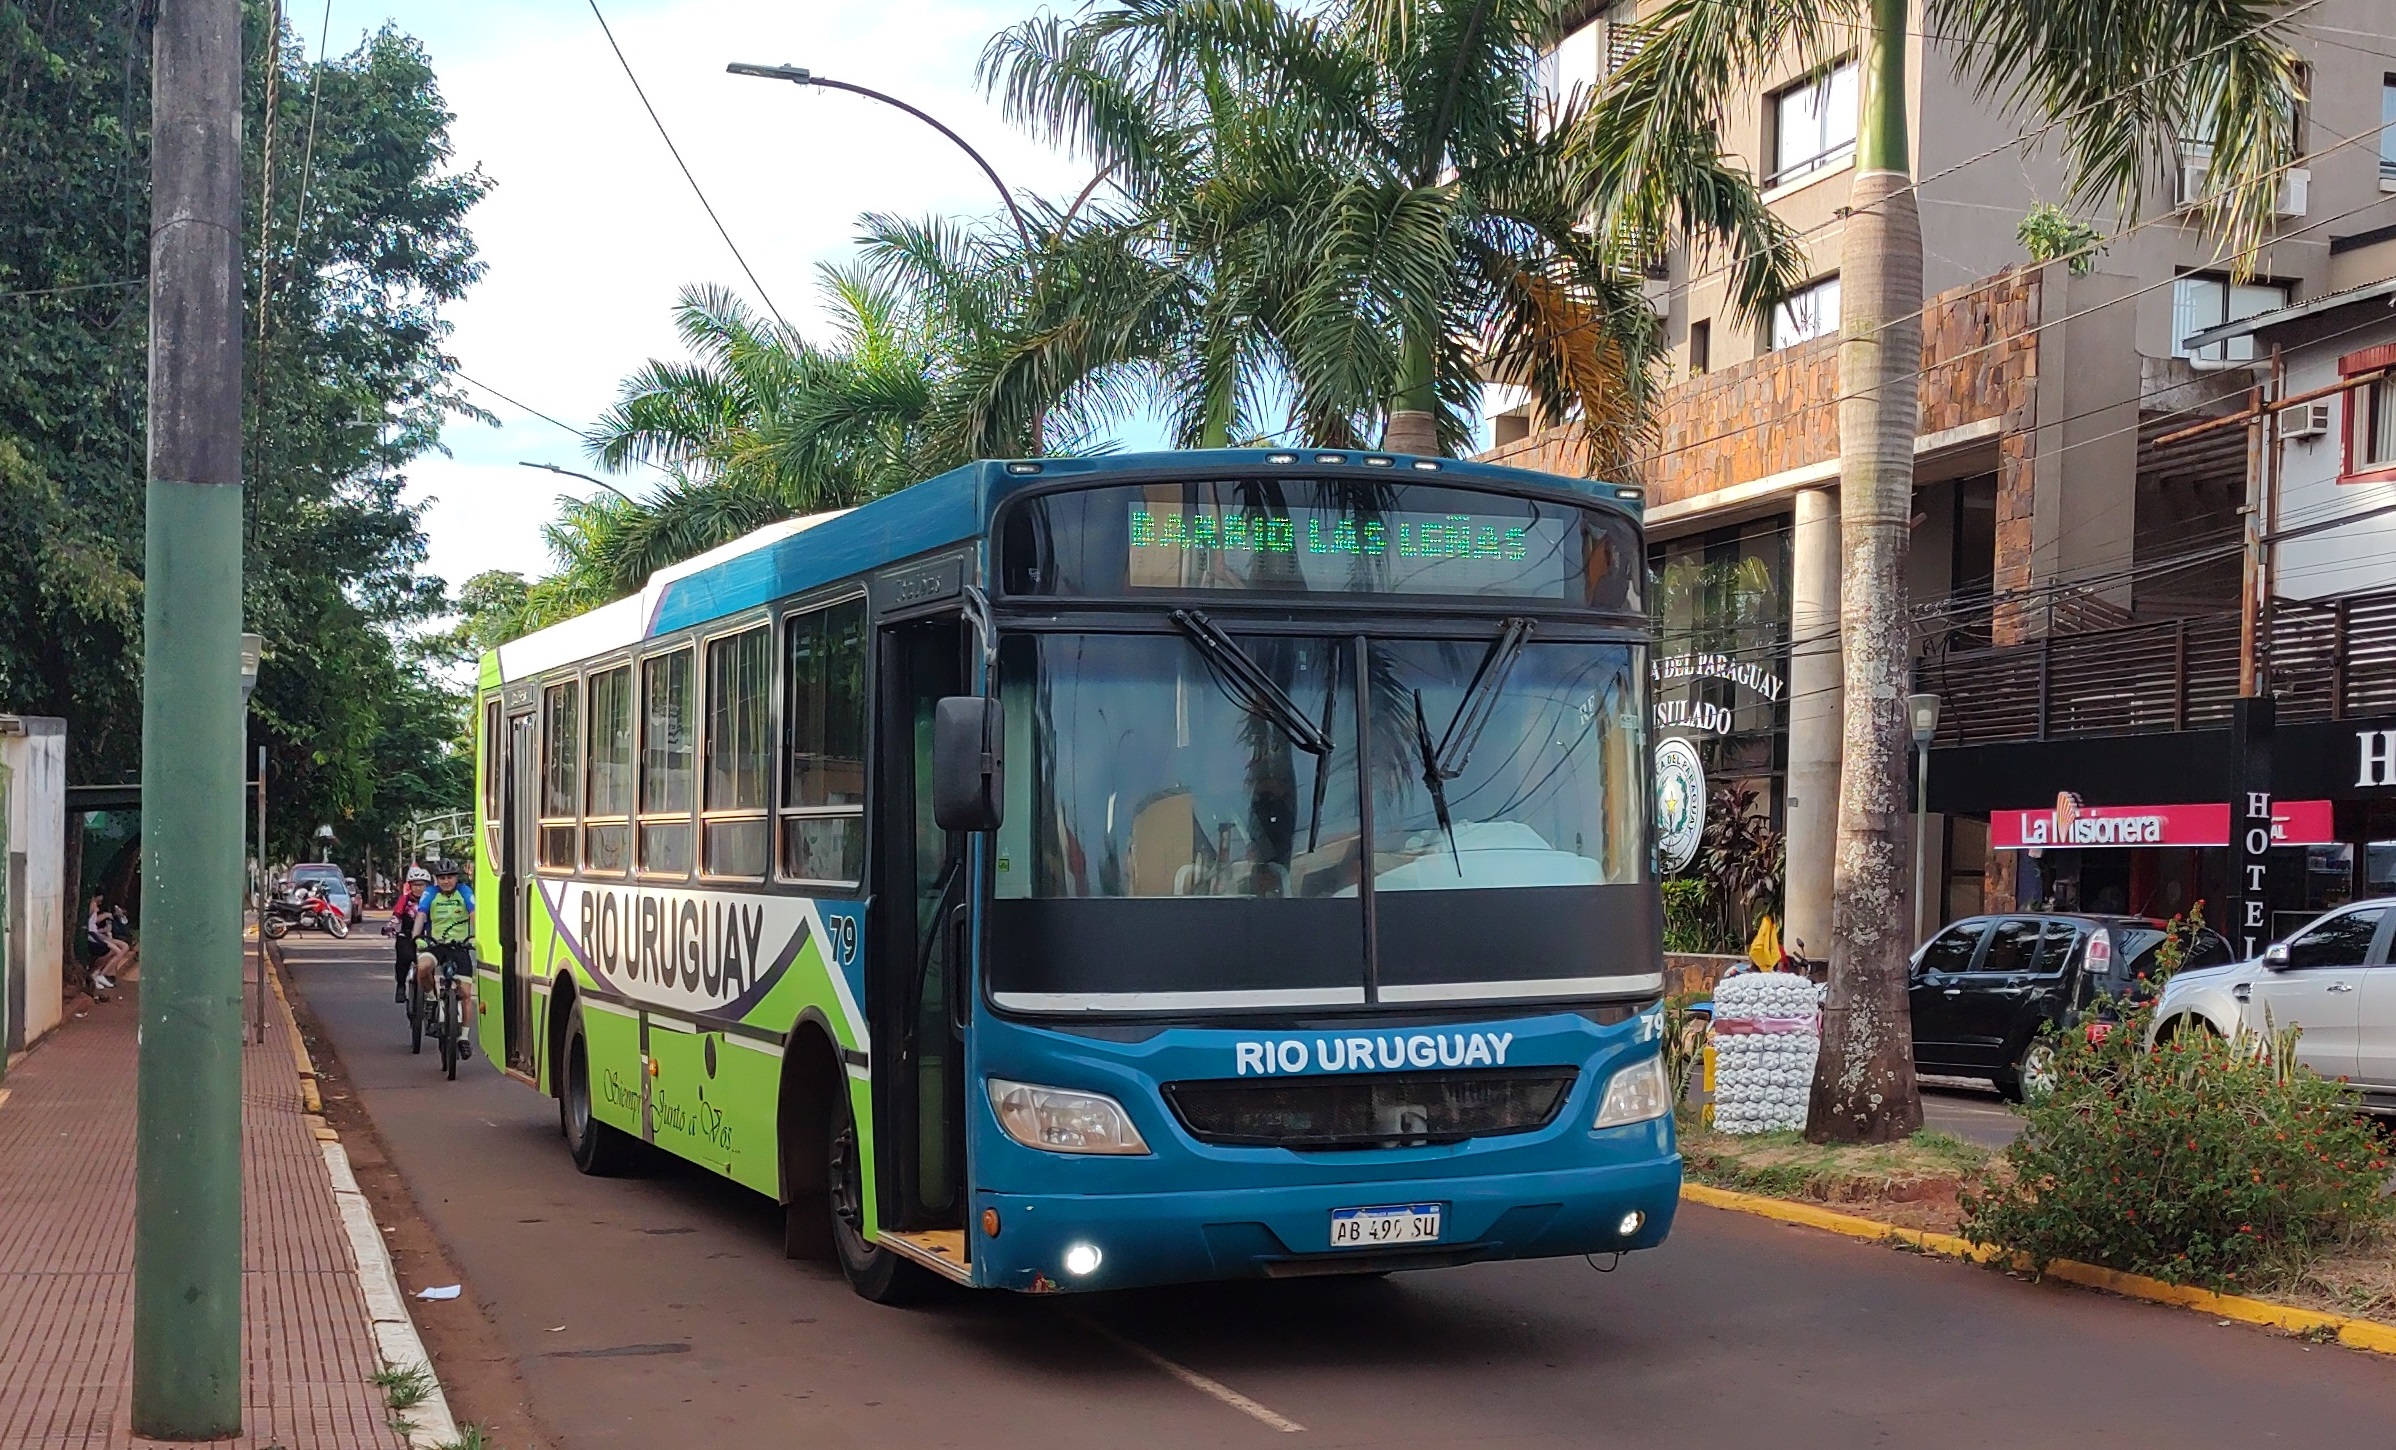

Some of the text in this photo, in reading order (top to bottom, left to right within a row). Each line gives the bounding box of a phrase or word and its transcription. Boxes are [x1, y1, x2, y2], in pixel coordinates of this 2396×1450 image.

[1131, 512, 1527, 561] BARRIO LAS LEÑAS
[1663, 654, 1694, 679] DEL
[1696, 652, 1784, 702] PARAGUAY
[2021, 809, 2161, 845] La Misionera
[581, 890, 764, 1001] RIO URUGUAY
[829, 914, 858, 966] 79
[1640, 1012, 1664, 1042] 79
[1236, 1032, 1514, 1076] RIO URUGUAY
[1338, 1221, 1361, 1241] AB
